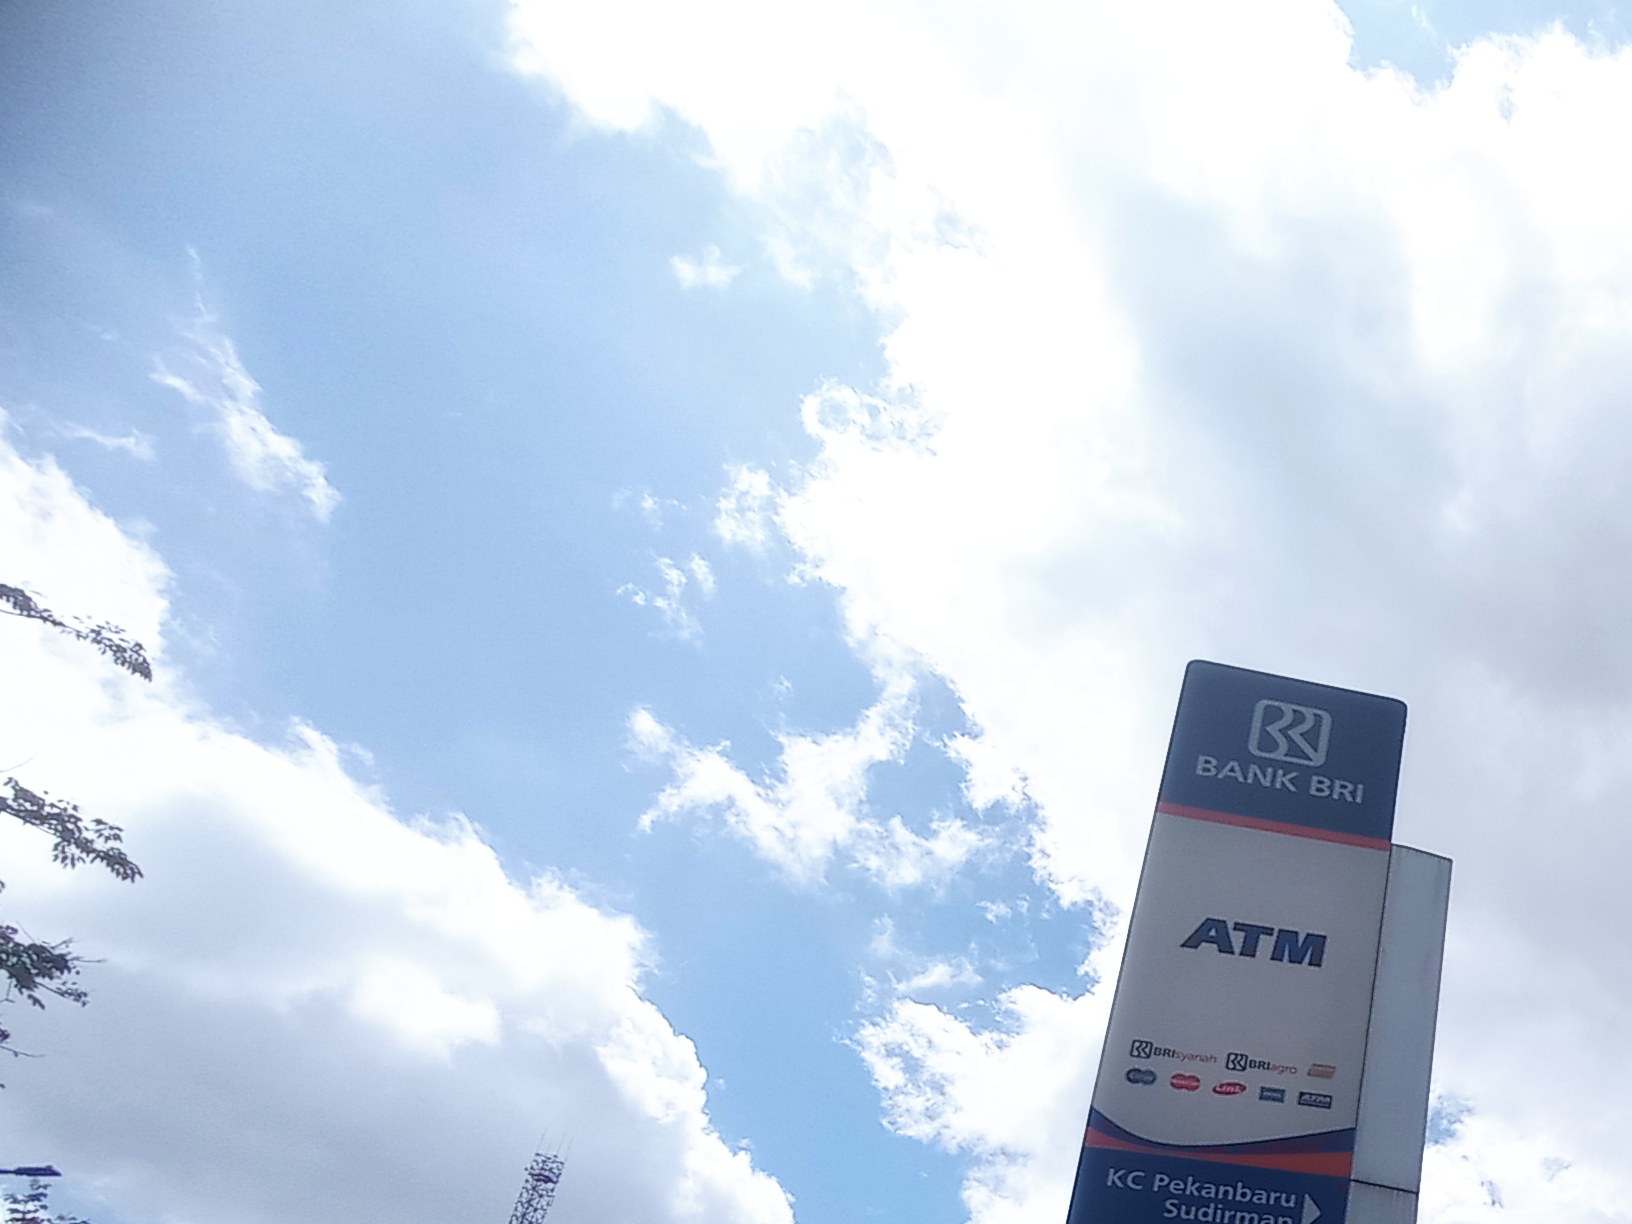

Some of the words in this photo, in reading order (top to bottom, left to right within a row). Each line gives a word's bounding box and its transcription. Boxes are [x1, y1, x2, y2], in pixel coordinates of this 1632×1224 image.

[1194, 756, 1298, 792] BANK
[1309, 777, 1364, 804] BRI
[1180, 916, 1328, 968] ATM
[1106, 1167, 1145, 1191] KC
[1152, 1173, 1297, 1208] Pekanbaru
